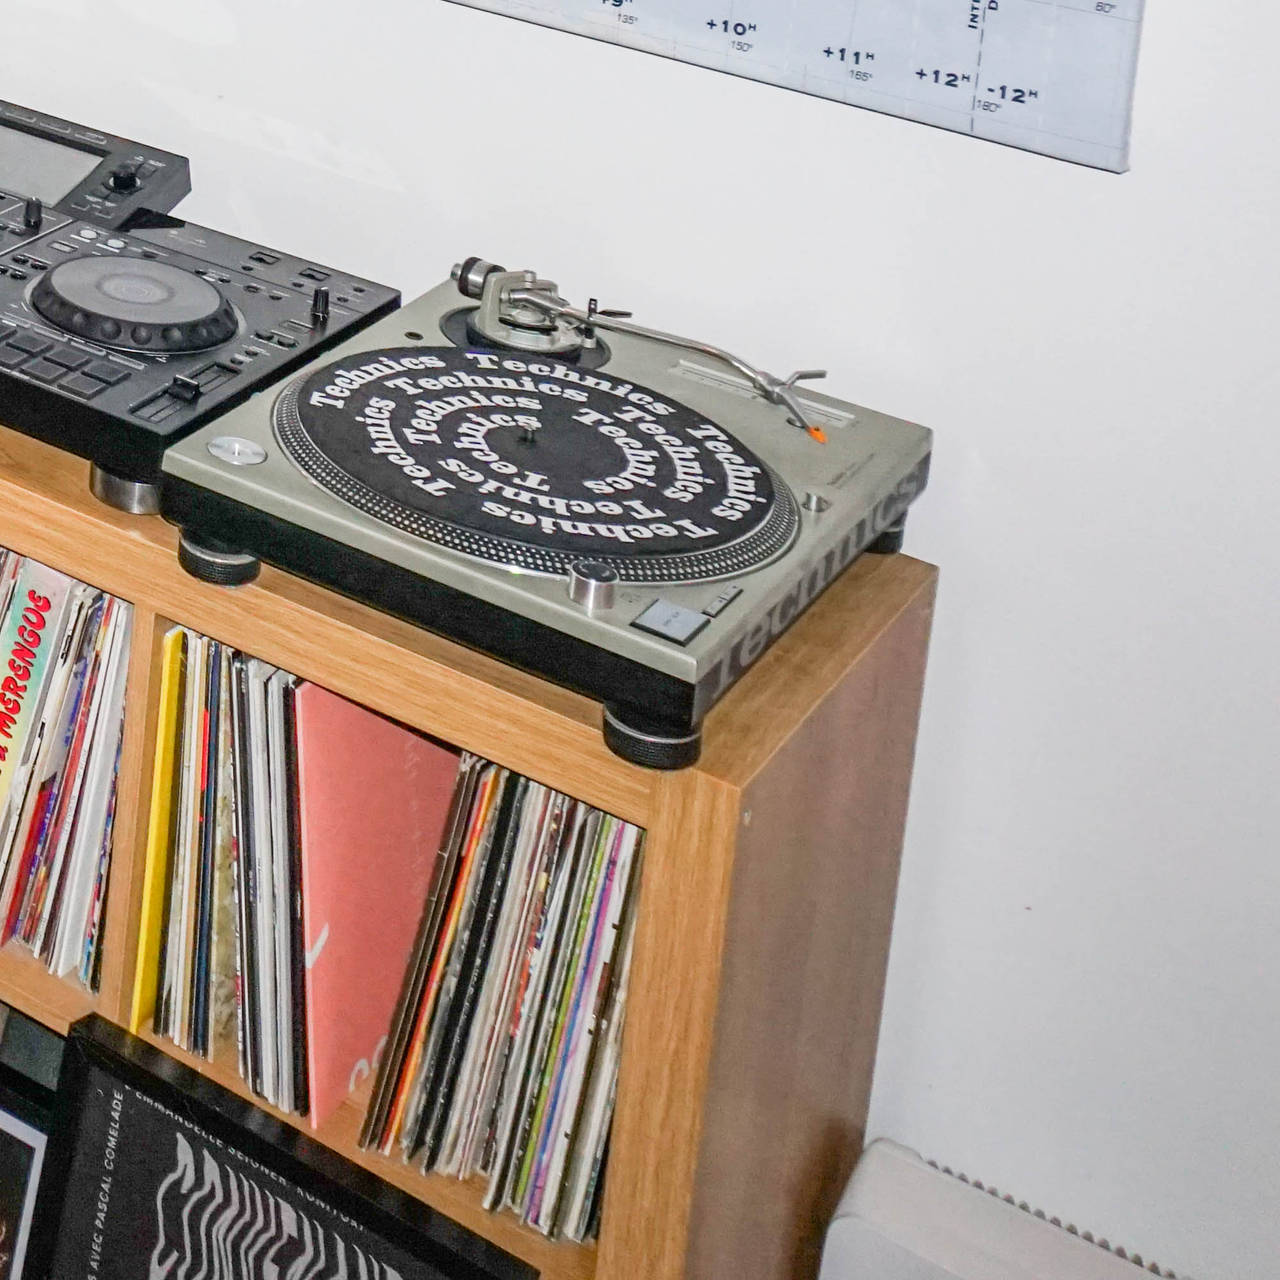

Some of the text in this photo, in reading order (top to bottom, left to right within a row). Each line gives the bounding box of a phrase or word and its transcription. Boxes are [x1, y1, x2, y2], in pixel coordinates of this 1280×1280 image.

[310, 353, 446, 410] Technics
[384, 371, 588, 402] Technics
[465, 352, 676, 416] Technics
[355, 396, 456, 496] Technics
[402, 391, 542, 447] Technics
[455, 412, 551, 491] Technics
[570, 407, 659, 495] Technics
[438, 458, 667, 522] Technics
[614, 406, 716, 504] Technics
[687, 425, 768, 522] Technics
[481, 501, 719, 544] Technics
[92, 1090, 124, 1271] AVEC PASCAL COMELADE
